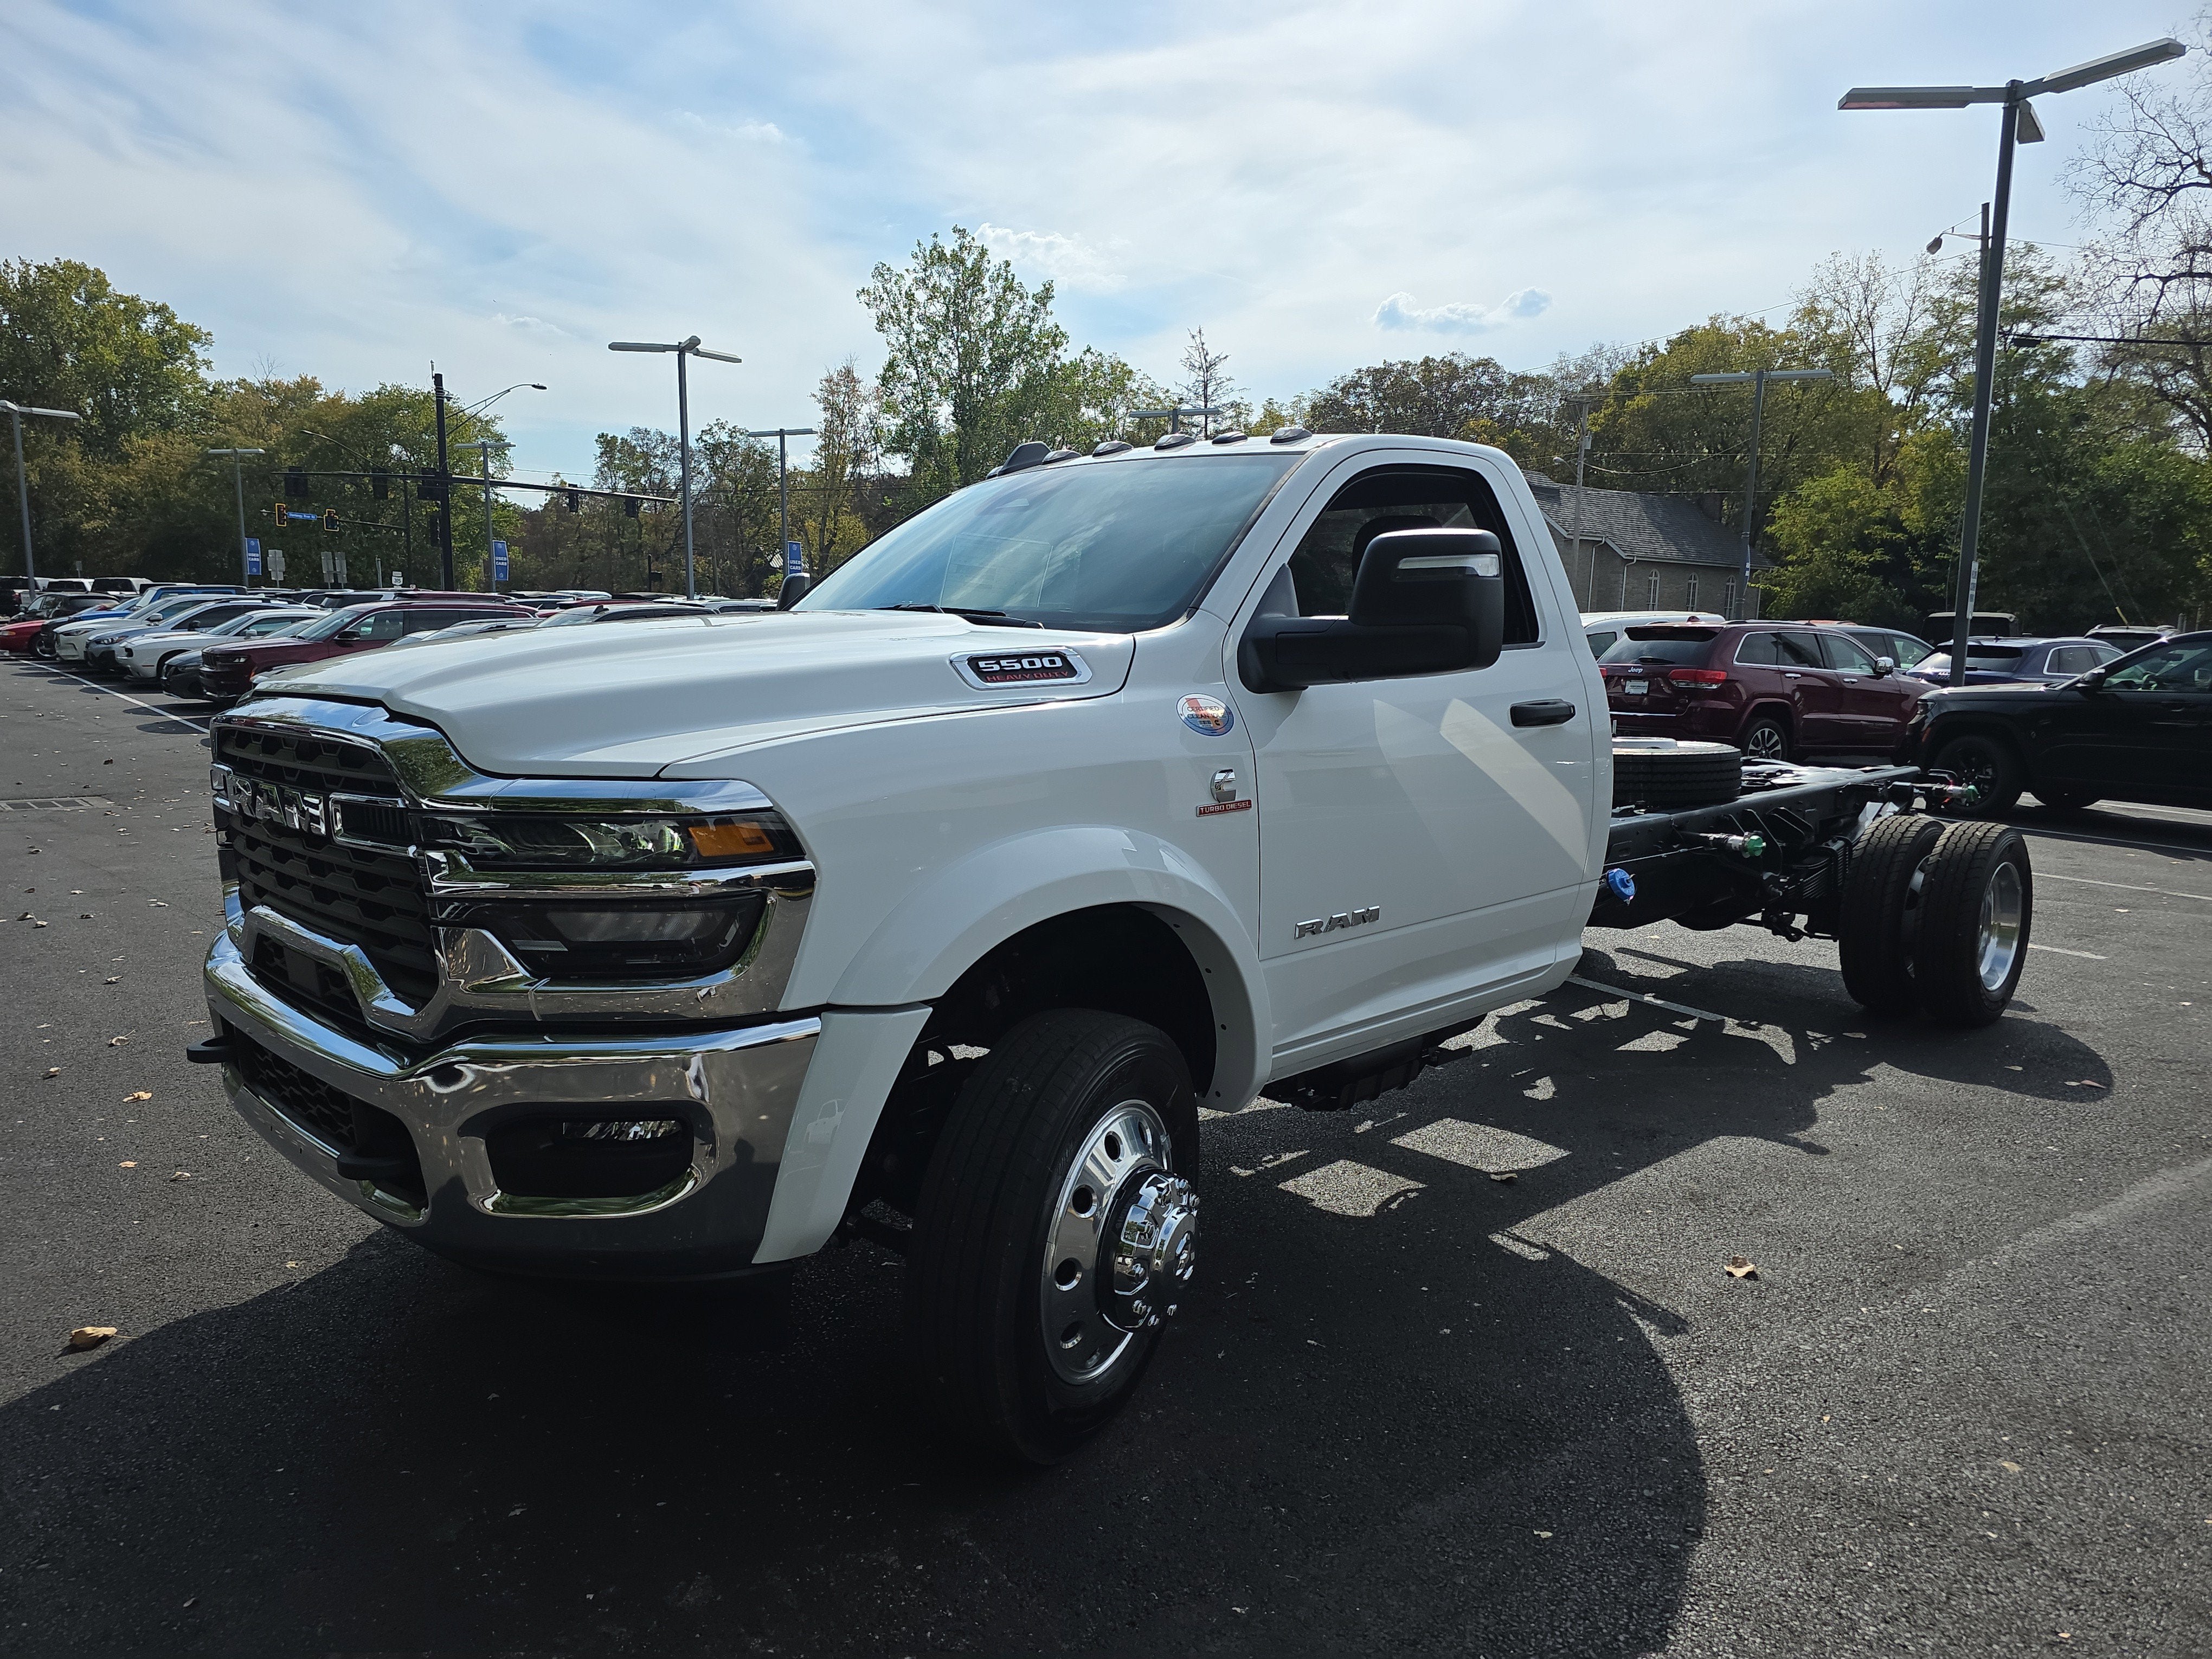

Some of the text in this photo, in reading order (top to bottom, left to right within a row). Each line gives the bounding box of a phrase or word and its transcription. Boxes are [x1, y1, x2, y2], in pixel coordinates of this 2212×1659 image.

[978, 657, 1063, 672] 5500
[986, 673, 1030, 682] HEAVY
[227, 774, 326, 835] RAM
[1226, 801, 1251, 809] DIESEL
[1294, 905, 1380, 940] RAM
